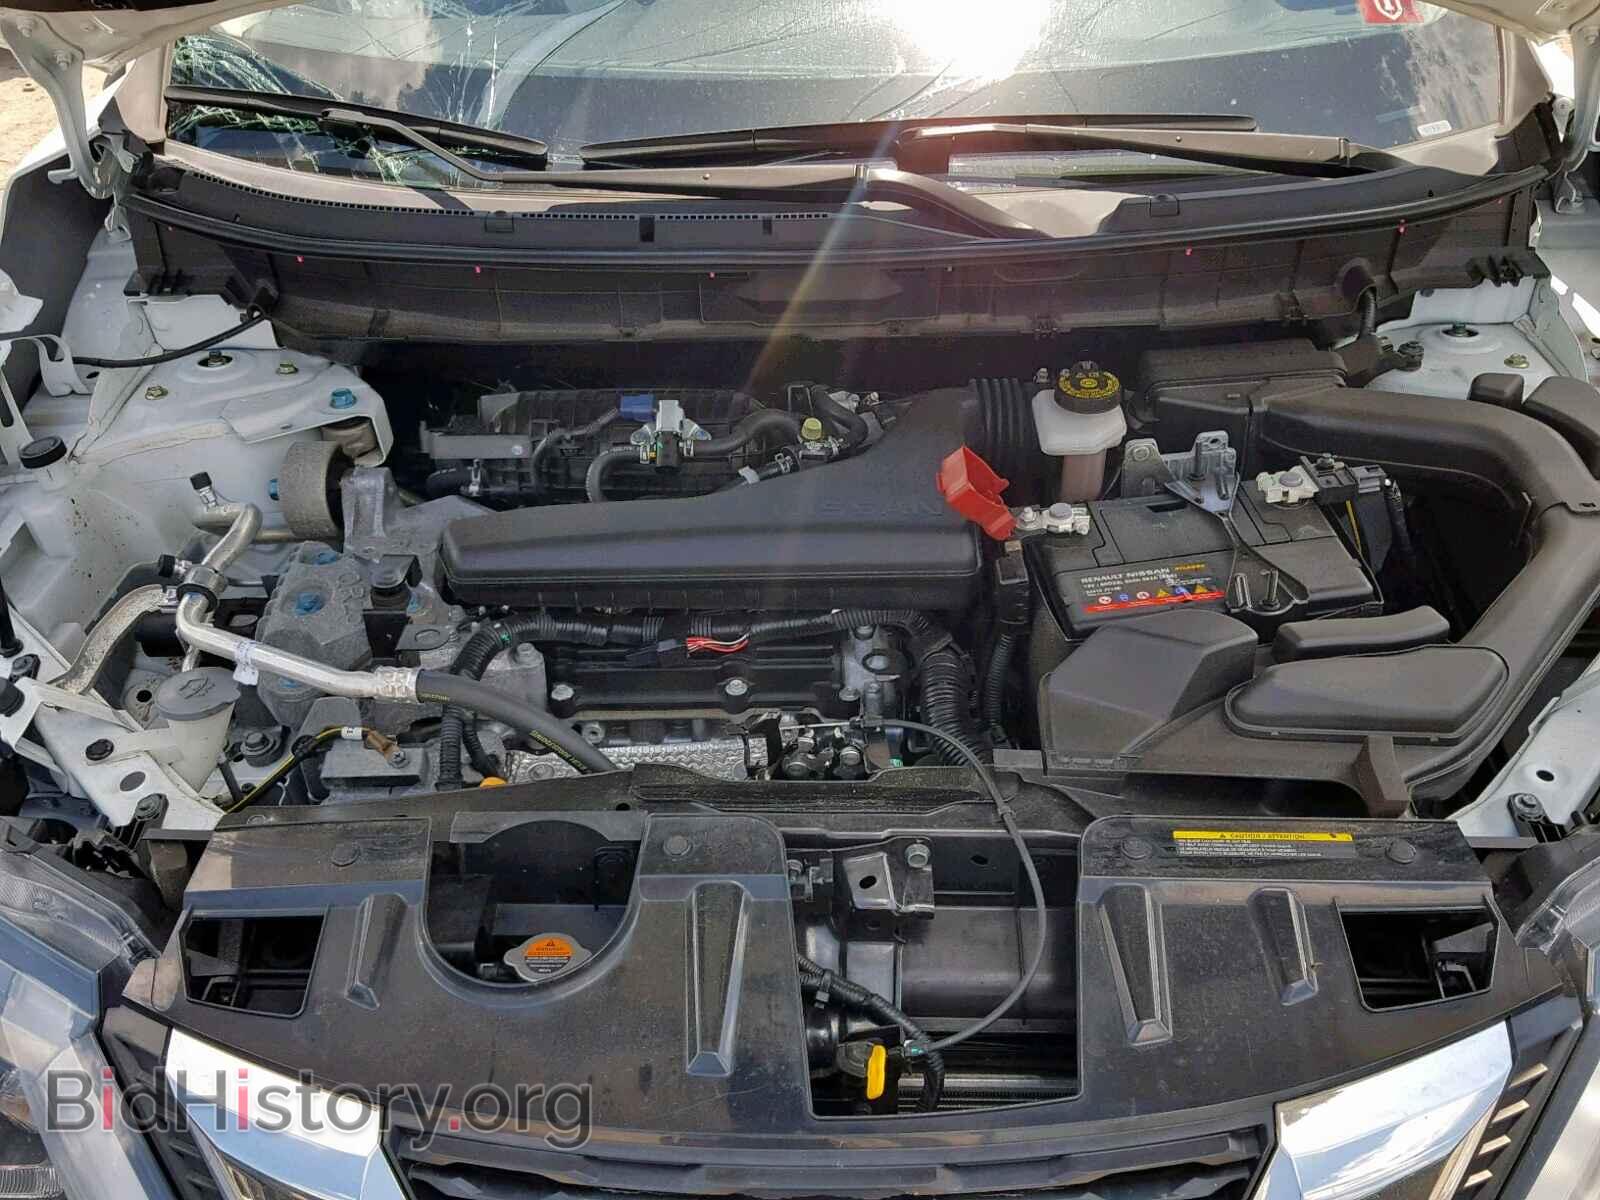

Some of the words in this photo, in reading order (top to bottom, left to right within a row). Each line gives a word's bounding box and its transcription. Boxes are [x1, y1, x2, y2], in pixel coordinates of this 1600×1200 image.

[1081, 574, 1122, 583] RENAULT
[1126, 567, 1170, 577] NISSAN
[1230, 832, 1261, 840] CAUTION
[1268, 832, 1305, 841] ATTENTION
